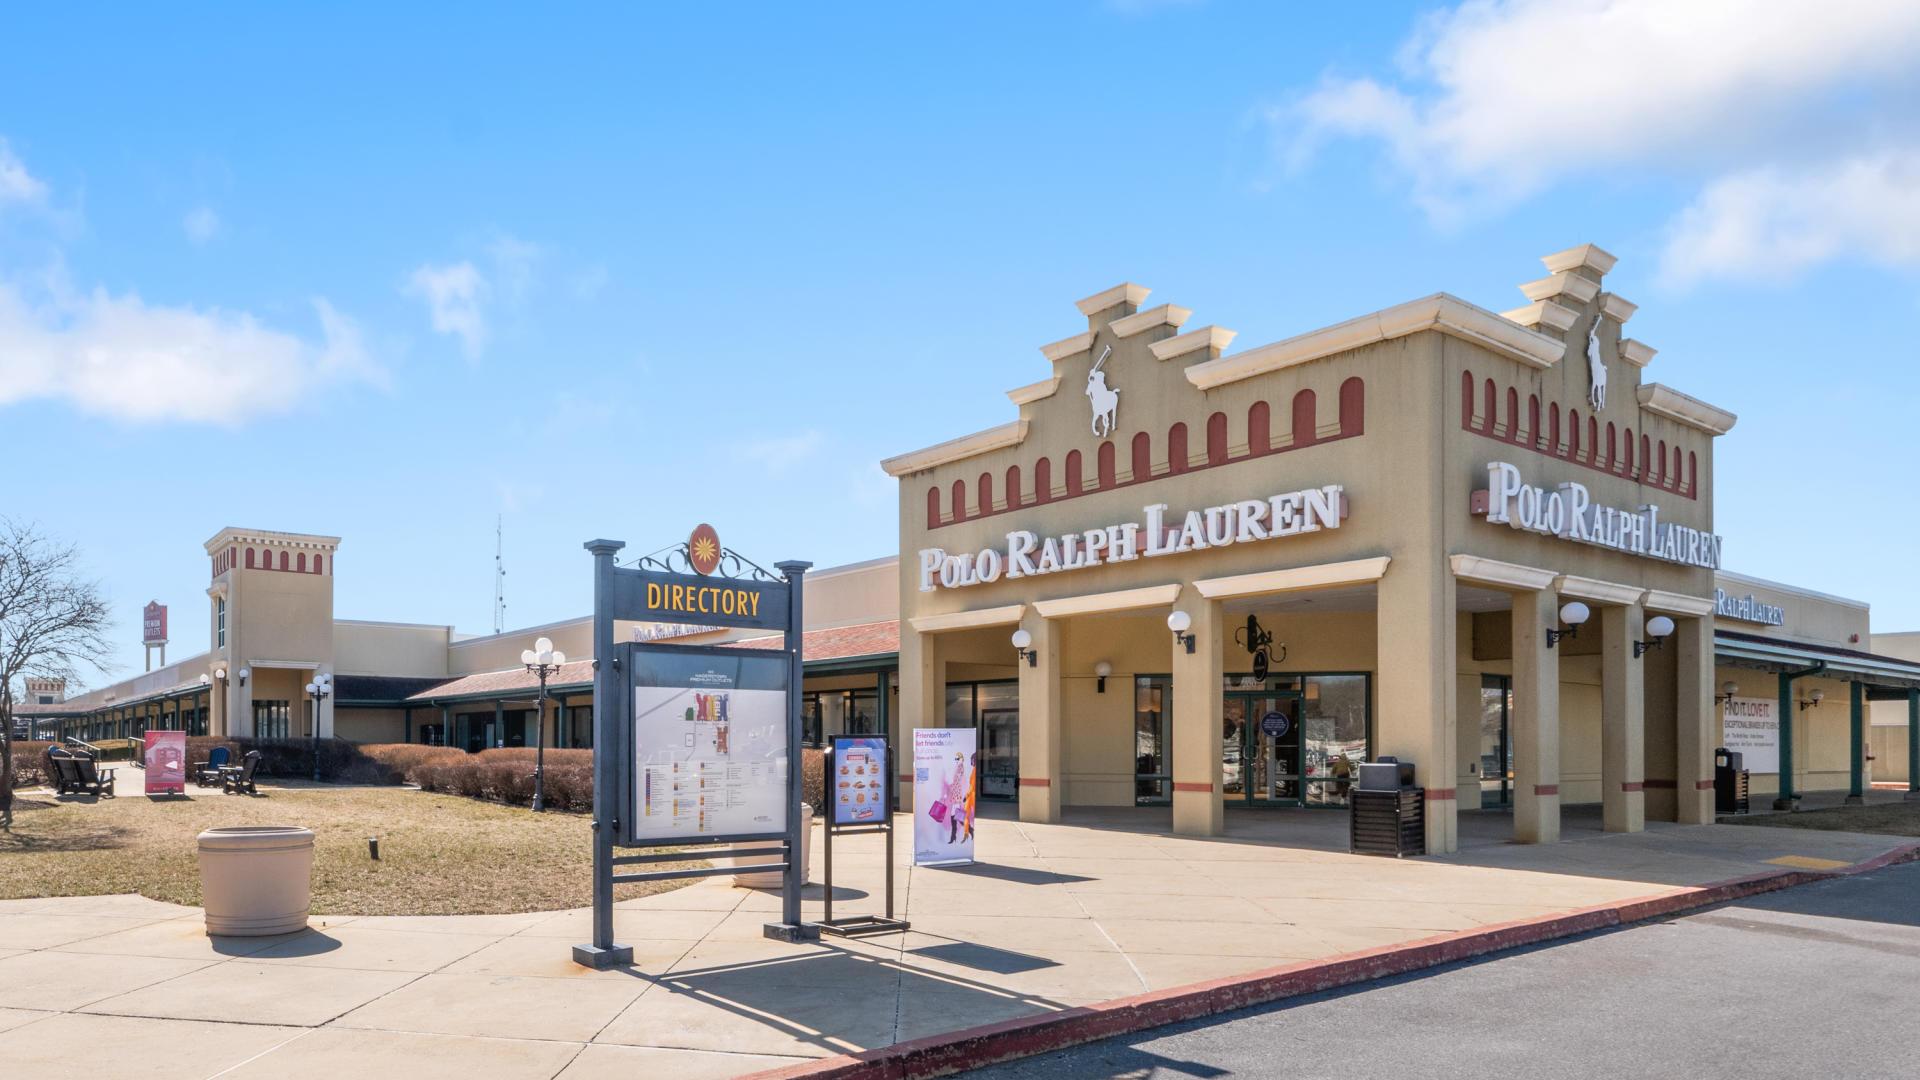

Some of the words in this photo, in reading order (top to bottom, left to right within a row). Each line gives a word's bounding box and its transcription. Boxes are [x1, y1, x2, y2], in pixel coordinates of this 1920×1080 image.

[918, 547, 1002, 592] POLO
[1006, 522, 1140, 579] RALPH
[1143, 484, 1344, 557] LAUREN
[1487, 461, 1564, 534] POLO
[1561, 481, 1646, 553] RALPH
[1643, 504, 1723, 571] LAUREN
[647, 582, 760, 617] DIRECTORY
